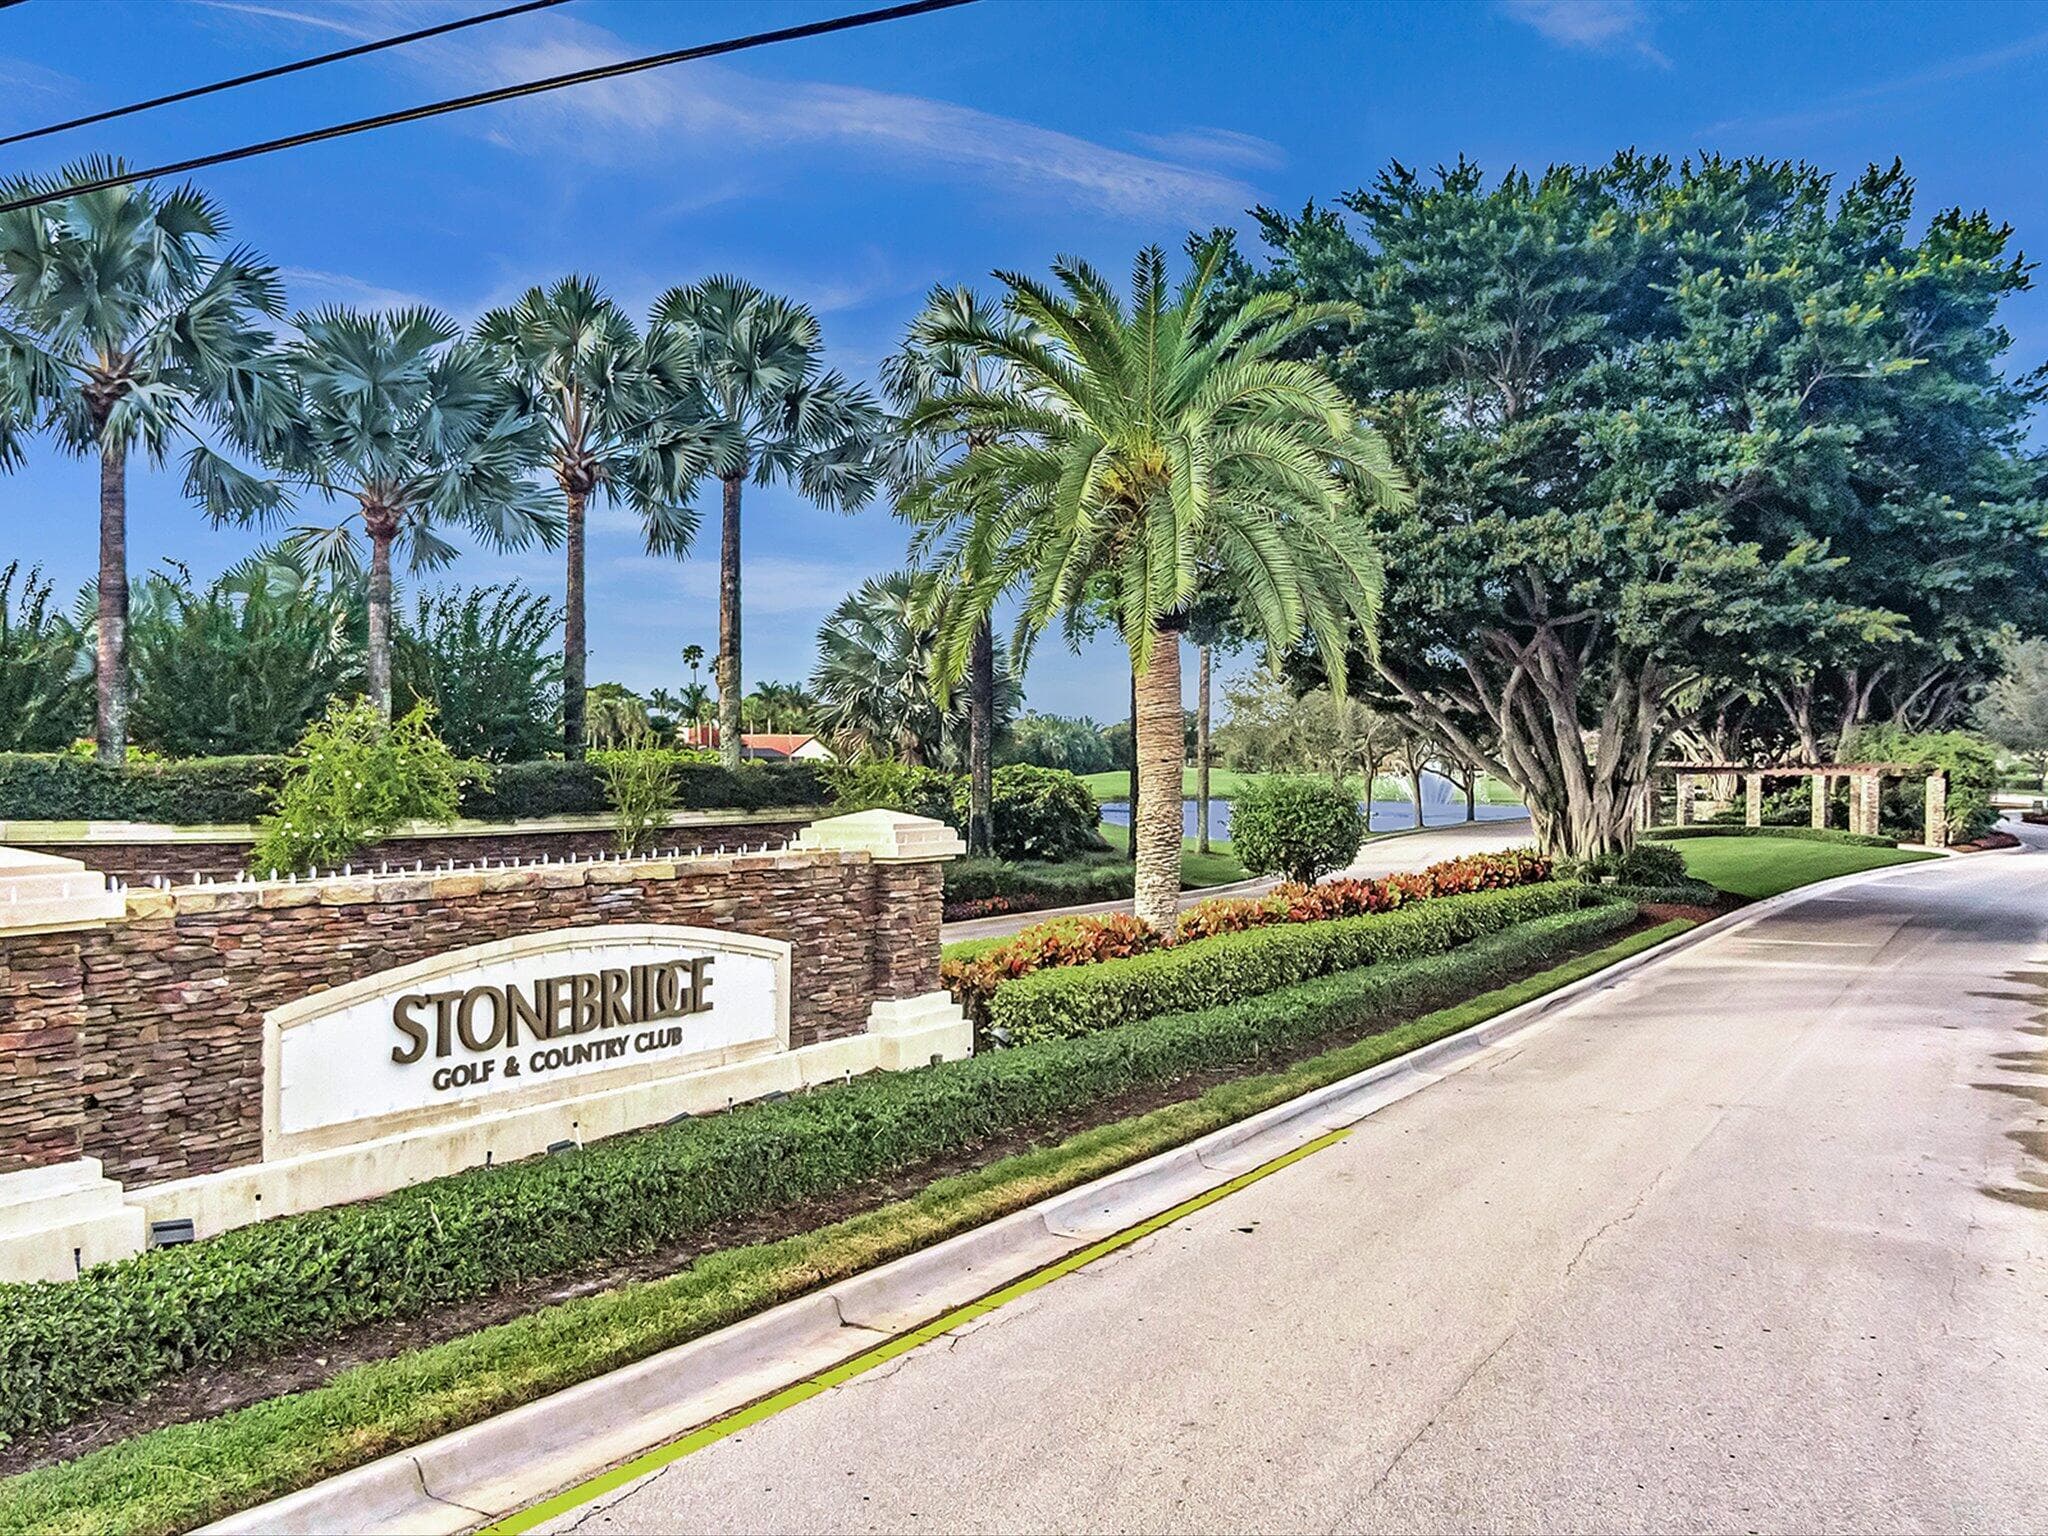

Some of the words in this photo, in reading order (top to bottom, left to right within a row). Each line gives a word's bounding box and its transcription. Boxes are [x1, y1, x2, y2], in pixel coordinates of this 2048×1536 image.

[393, 956, 714, 1063] STONEBRIDGE
[433, 1059, 495, 1090] GOLF
[503, 1056, 521, 1077] &
[530, 1034, 630, 1073] COUNTRY
[634, 1026, 683, 1053] CLUB
